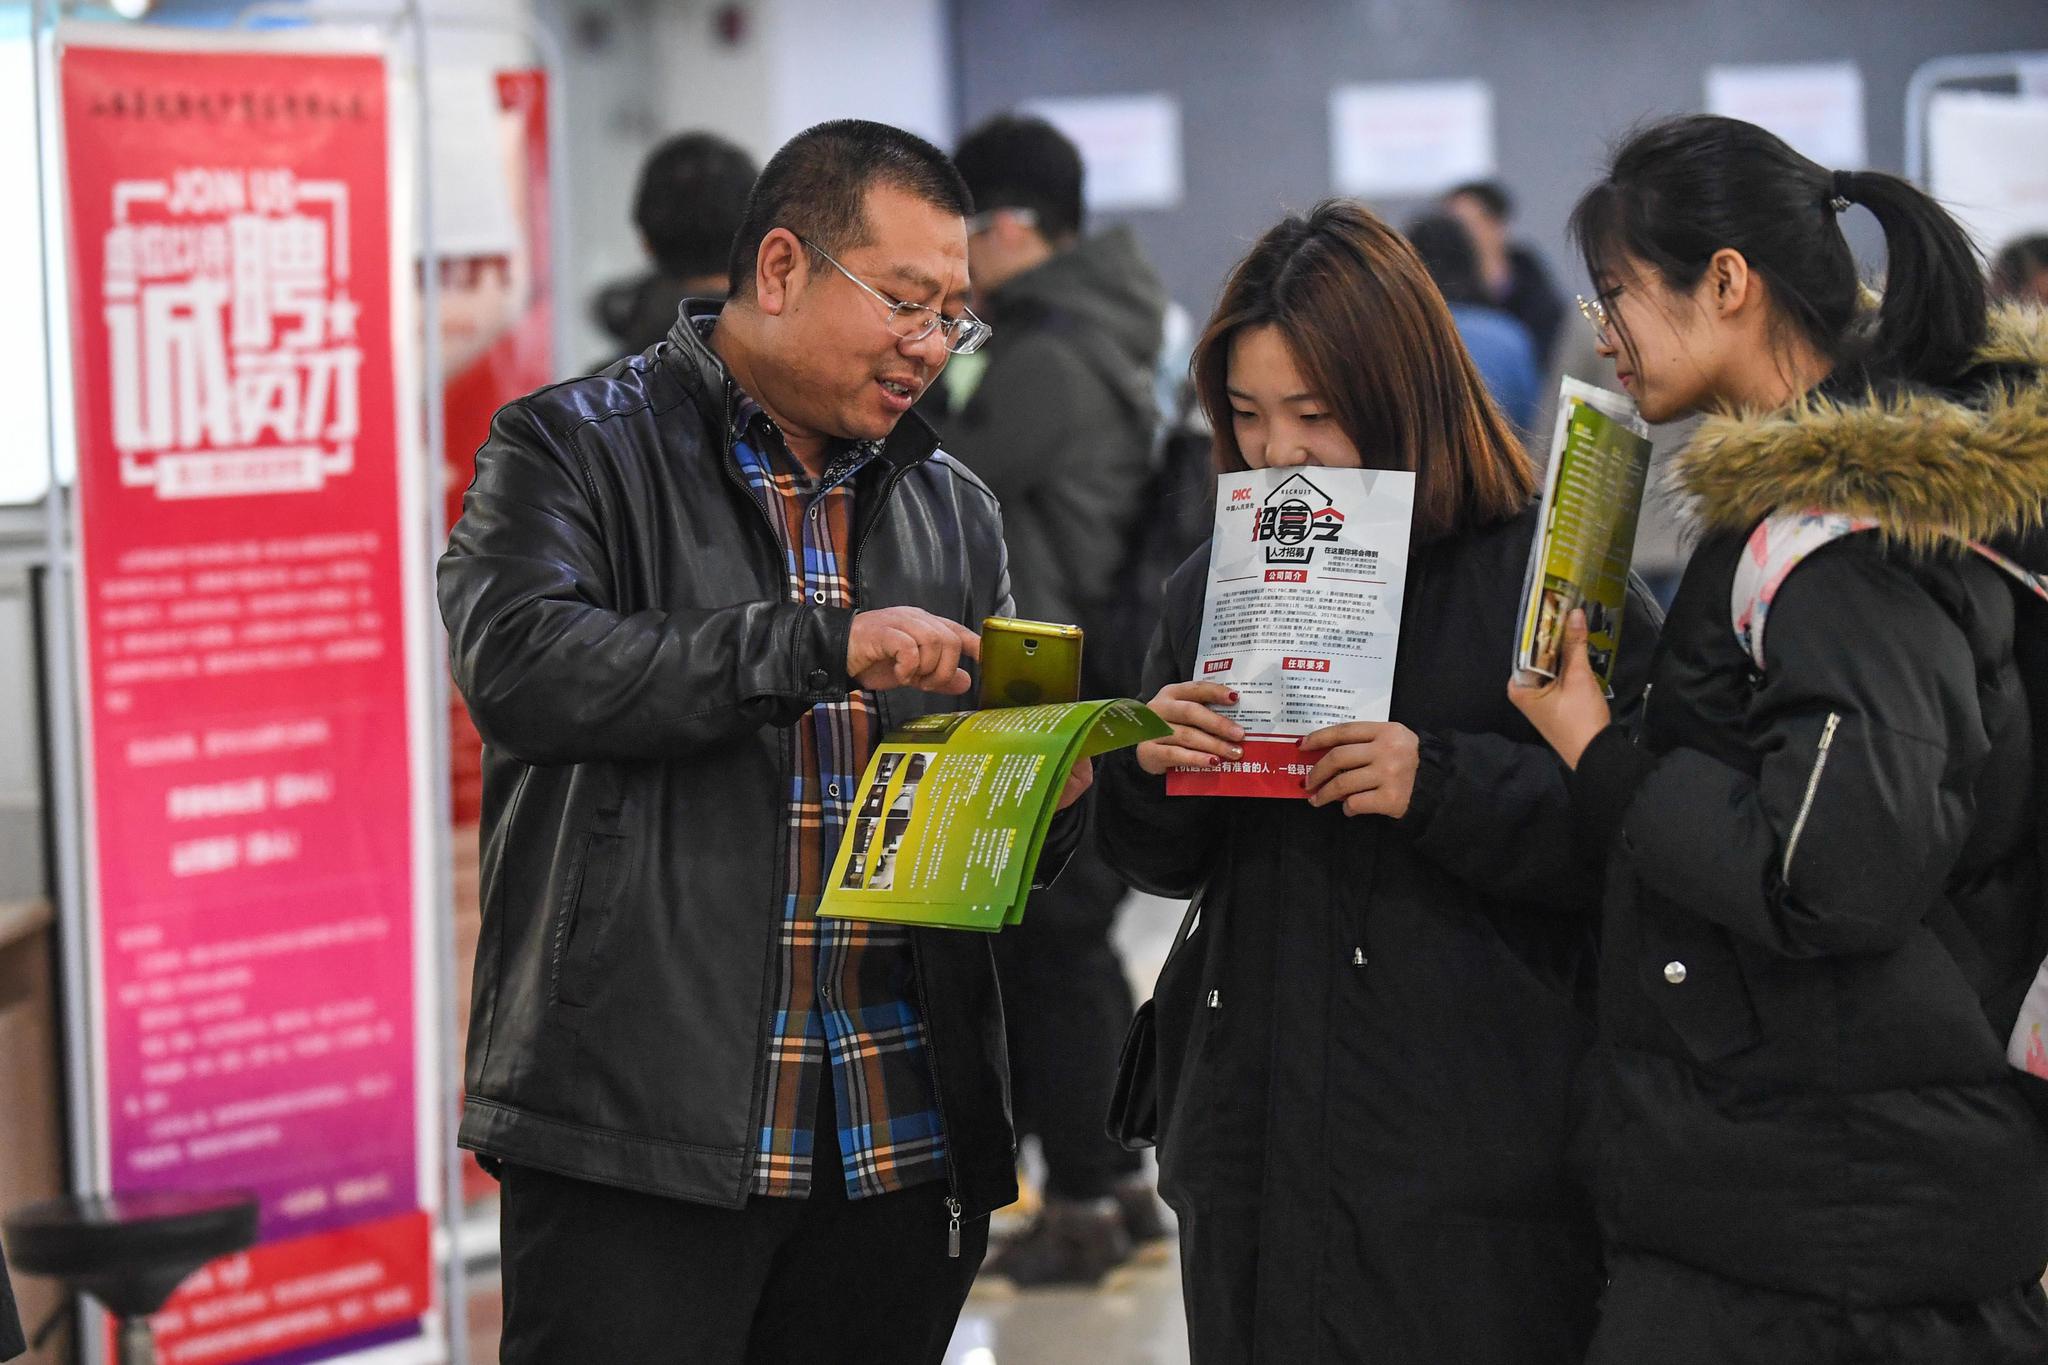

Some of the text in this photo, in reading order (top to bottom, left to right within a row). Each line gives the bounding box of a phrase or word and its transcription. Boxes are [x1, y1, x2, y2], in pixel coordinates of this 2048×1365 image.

[168, 168, 295, 214] JOIN US
[1232, 488, 1252, 501] PICC
[1251, 505, 1345, 542] 招募令
[1270, 547, 1305, 558] 人才招募
[1268, 571, 1302, 581] 公司简介
[1288, 659, 1325, 671] 任职要求
